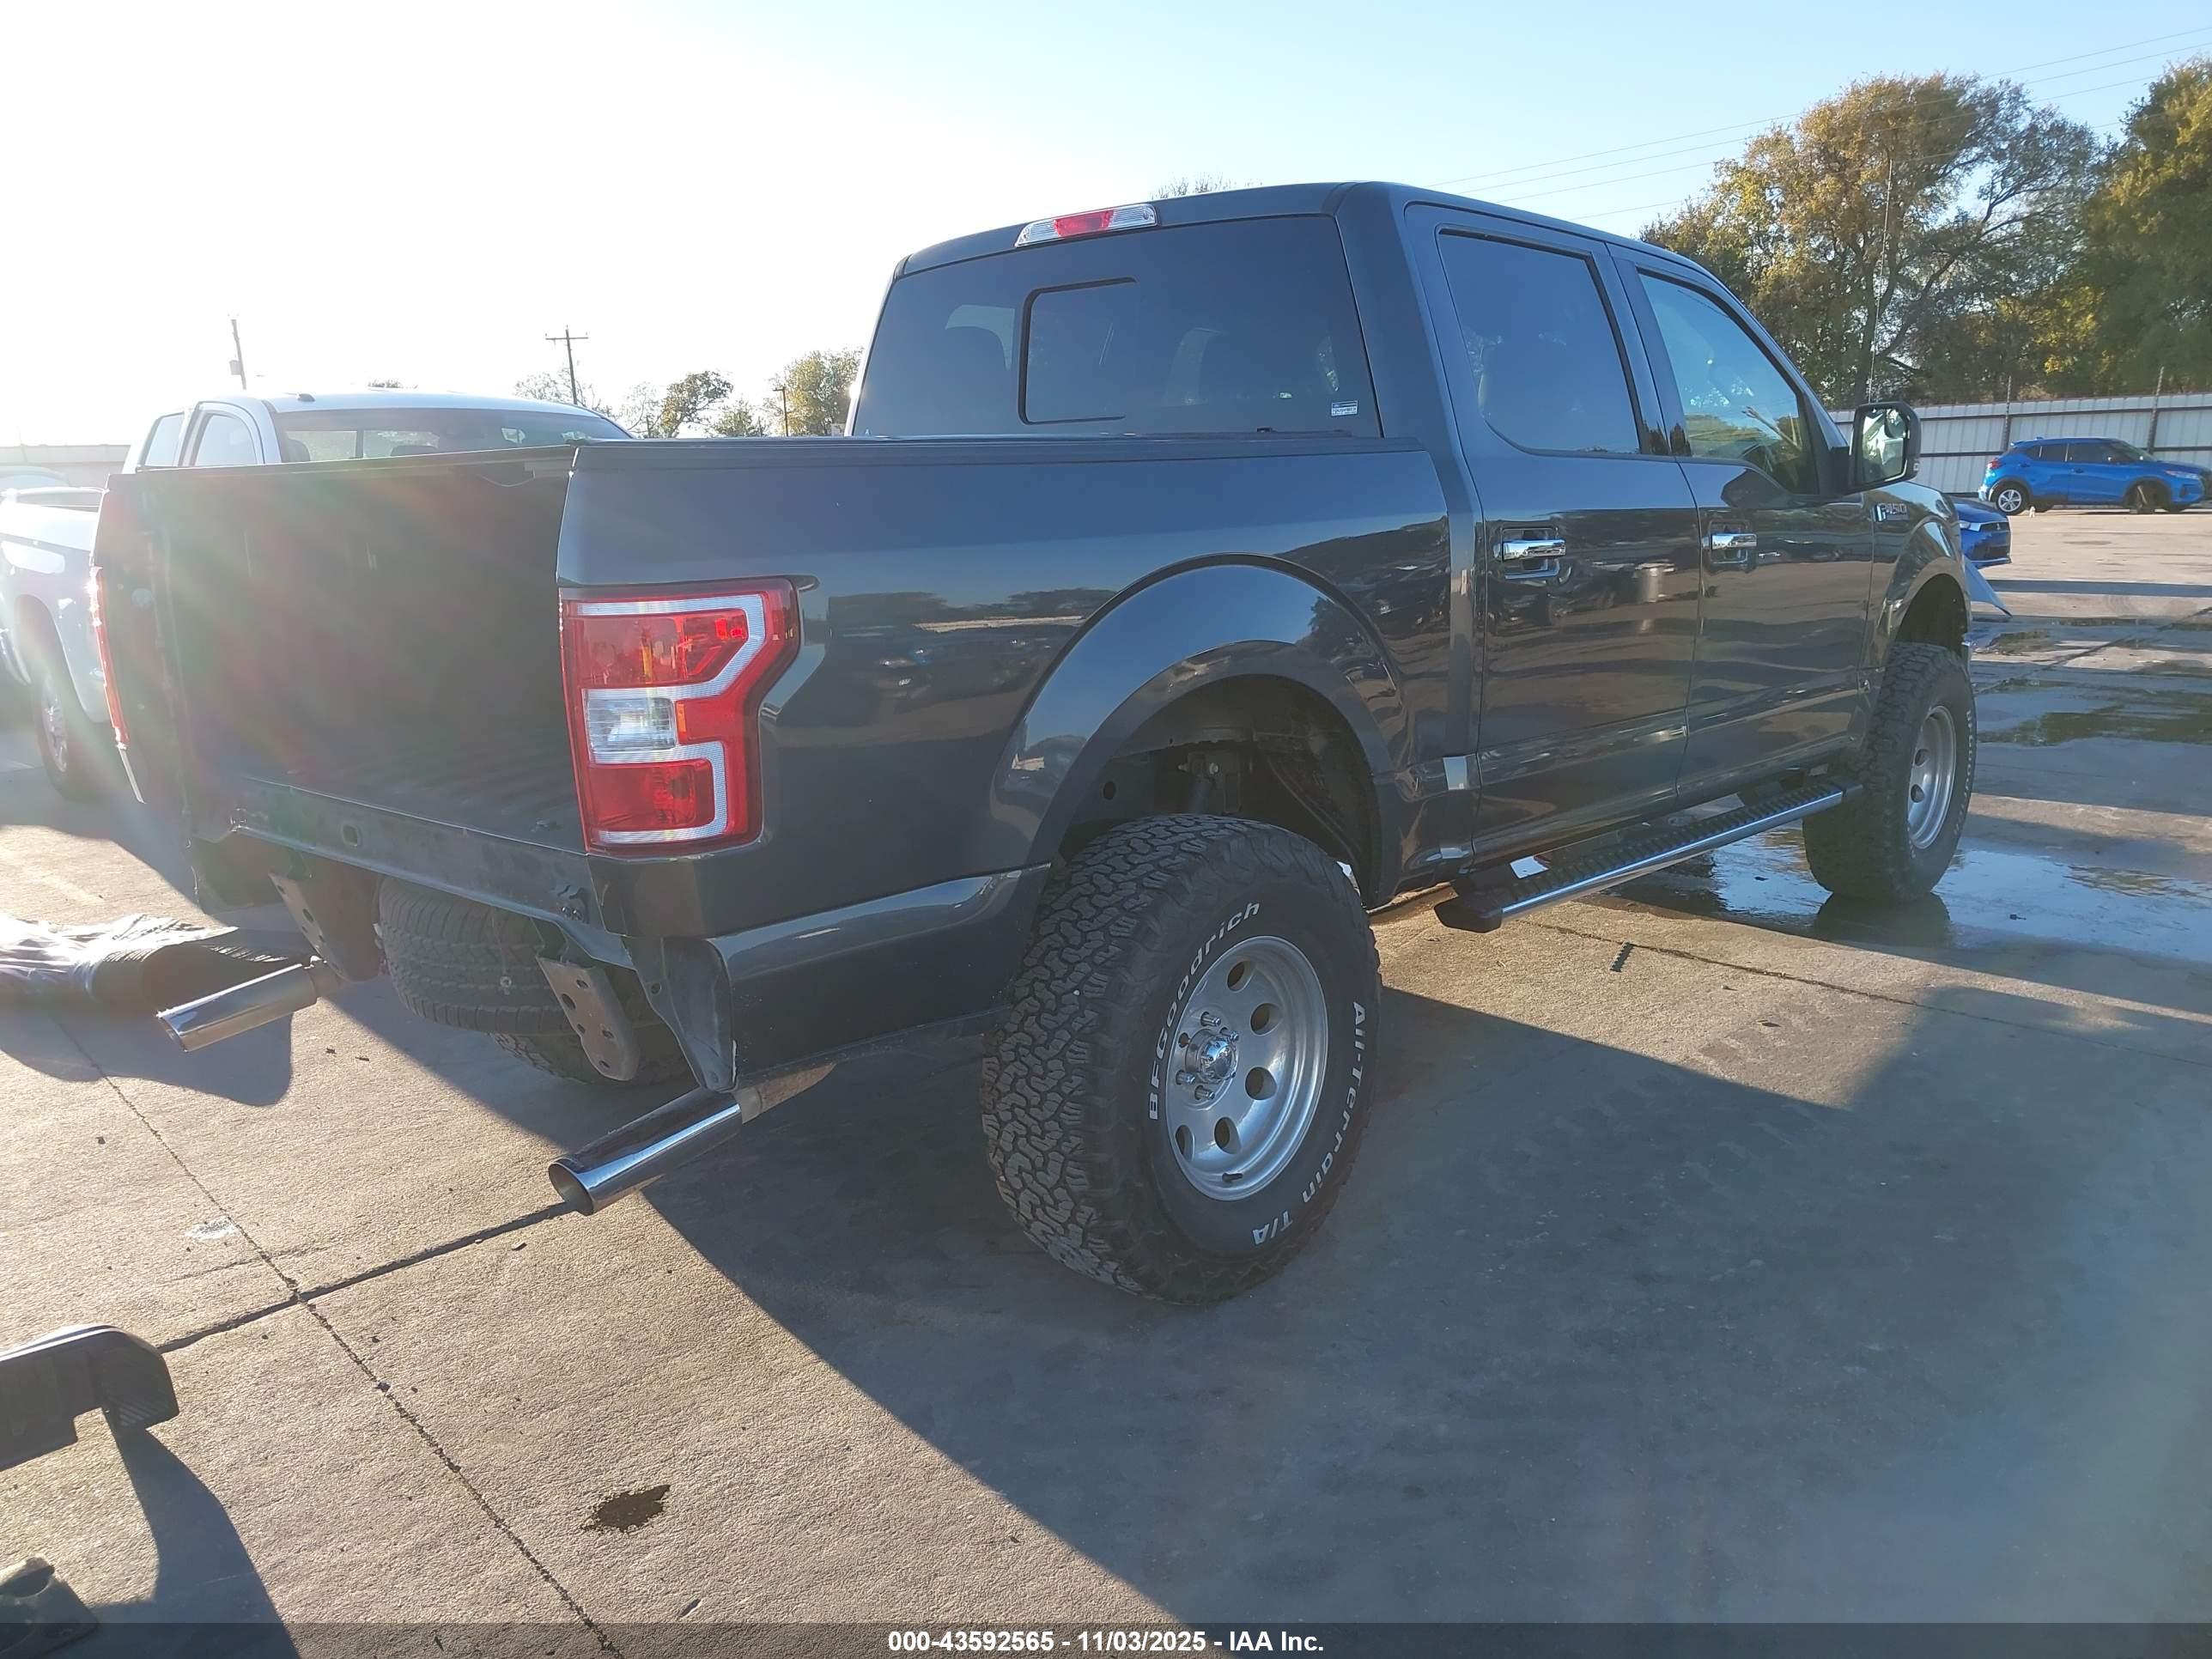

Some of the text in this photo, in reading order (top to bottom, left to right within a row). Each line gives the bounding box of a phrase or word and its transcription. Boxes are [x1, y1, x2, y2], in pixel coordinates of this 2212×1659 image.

[1149, 902, 1261, 1120] BFGoodrich
[1252, 1001, 1367, 1244] All-Terrain T/A
